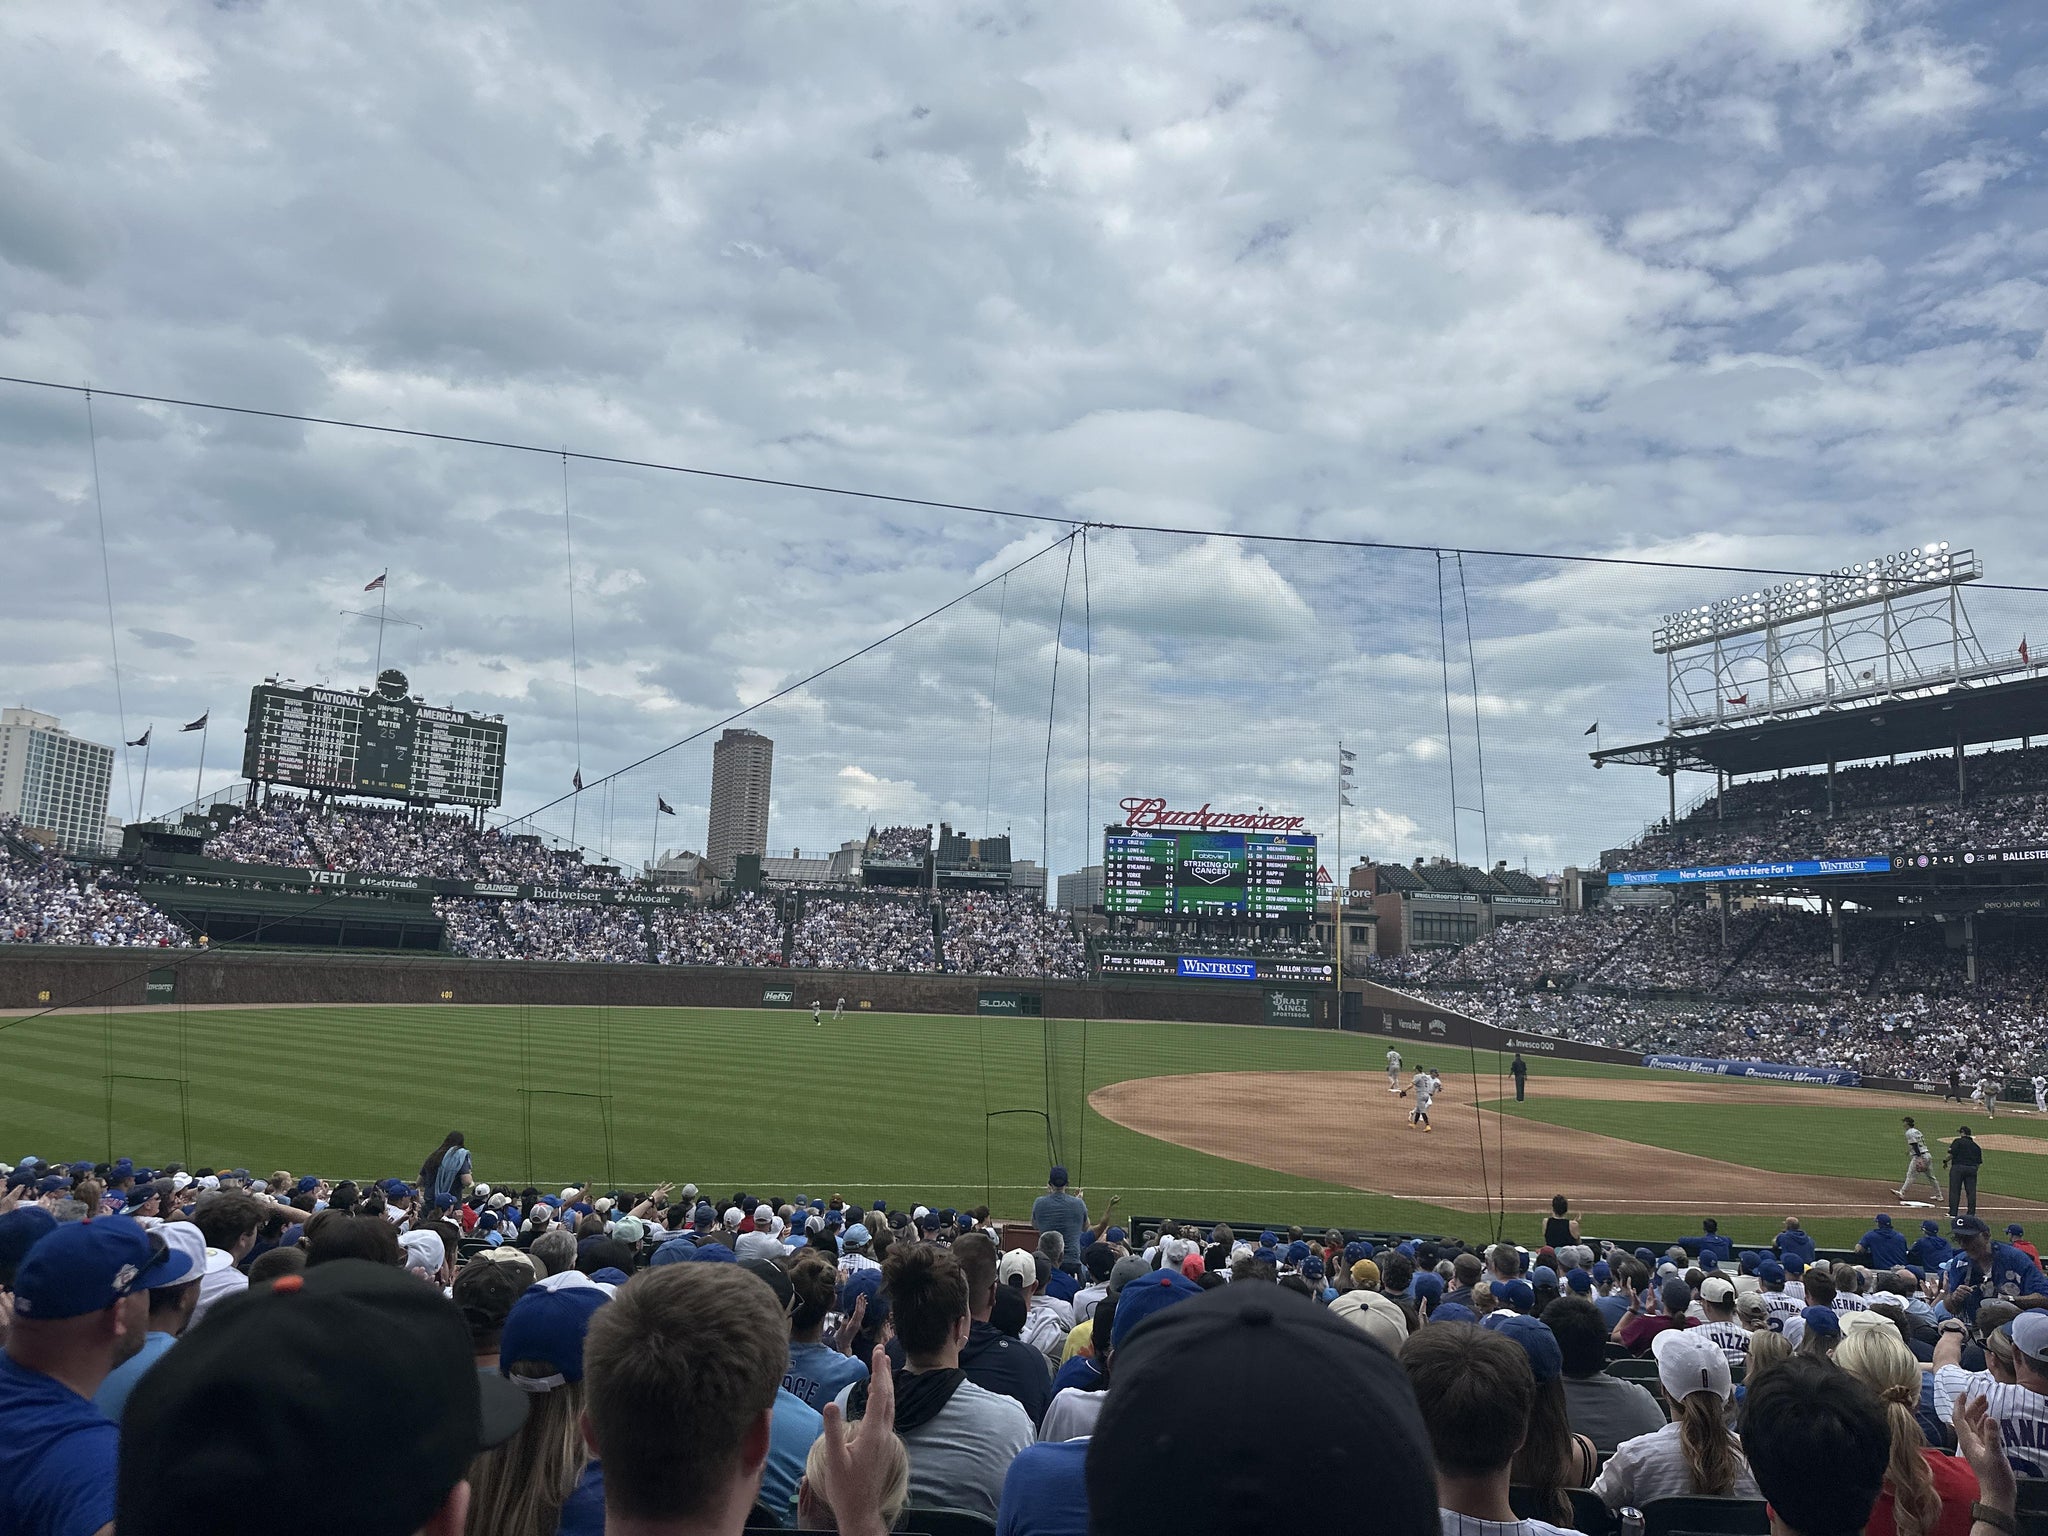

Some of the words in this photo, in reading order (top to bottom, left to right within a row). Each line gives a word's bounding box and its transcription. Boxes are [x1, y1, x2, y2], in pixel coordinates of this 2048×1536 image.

[313, 690, 364, 708] NATIONAL
[378, 704, 404, 714] UMPIRES
[416, 708, 464, 724] AMERICAN
[378, 720, 400, 729] BATTER
[380, 728, 396, 739] 25
[397, 751, 404, 760] 2
[1120, 798, 1304, 830] Budweiser
[174, 825, 201, 838] Mobile
[1131, 830, 1153, 838] Pirates
[1819, 861, 1866, 871] WINTRUST
[1680, 871, 1696, 880] New
[1697, 869, 1726, 878] Season,
[1727, 867, 1749, 876] We're
[1750, 866, 1769, 875] Here
[1771, 865, 1785, 874] For
[1786, 864, 1793, 873] It
[308, 870, 346, 884] YETI
[367, 877, 418, 888] tastytrade
[474, 882, 519, 893] GRAINGER
[533, 886, 600, 900] Budweiser
[627, 893, 671, 904] Advocate
[1333, 887, 1371, 898] Moore
[1104, 955, 1110, 964] P
[1183, 960, 1251, 974] WINTRUST
[146, 982, 174, 992] Invenergy
[765, 992, 790, 1000] Hefty
[979, 1000, 1016, 1008] SLOAN
[1516, 1040, 1539, 1049] Invesco
[1541, 1042, 1554, 1050] QQQ
[1649, 1058, 1689, 1071] Reynolds
[1914, 1083, 1935, 1092] meijer
